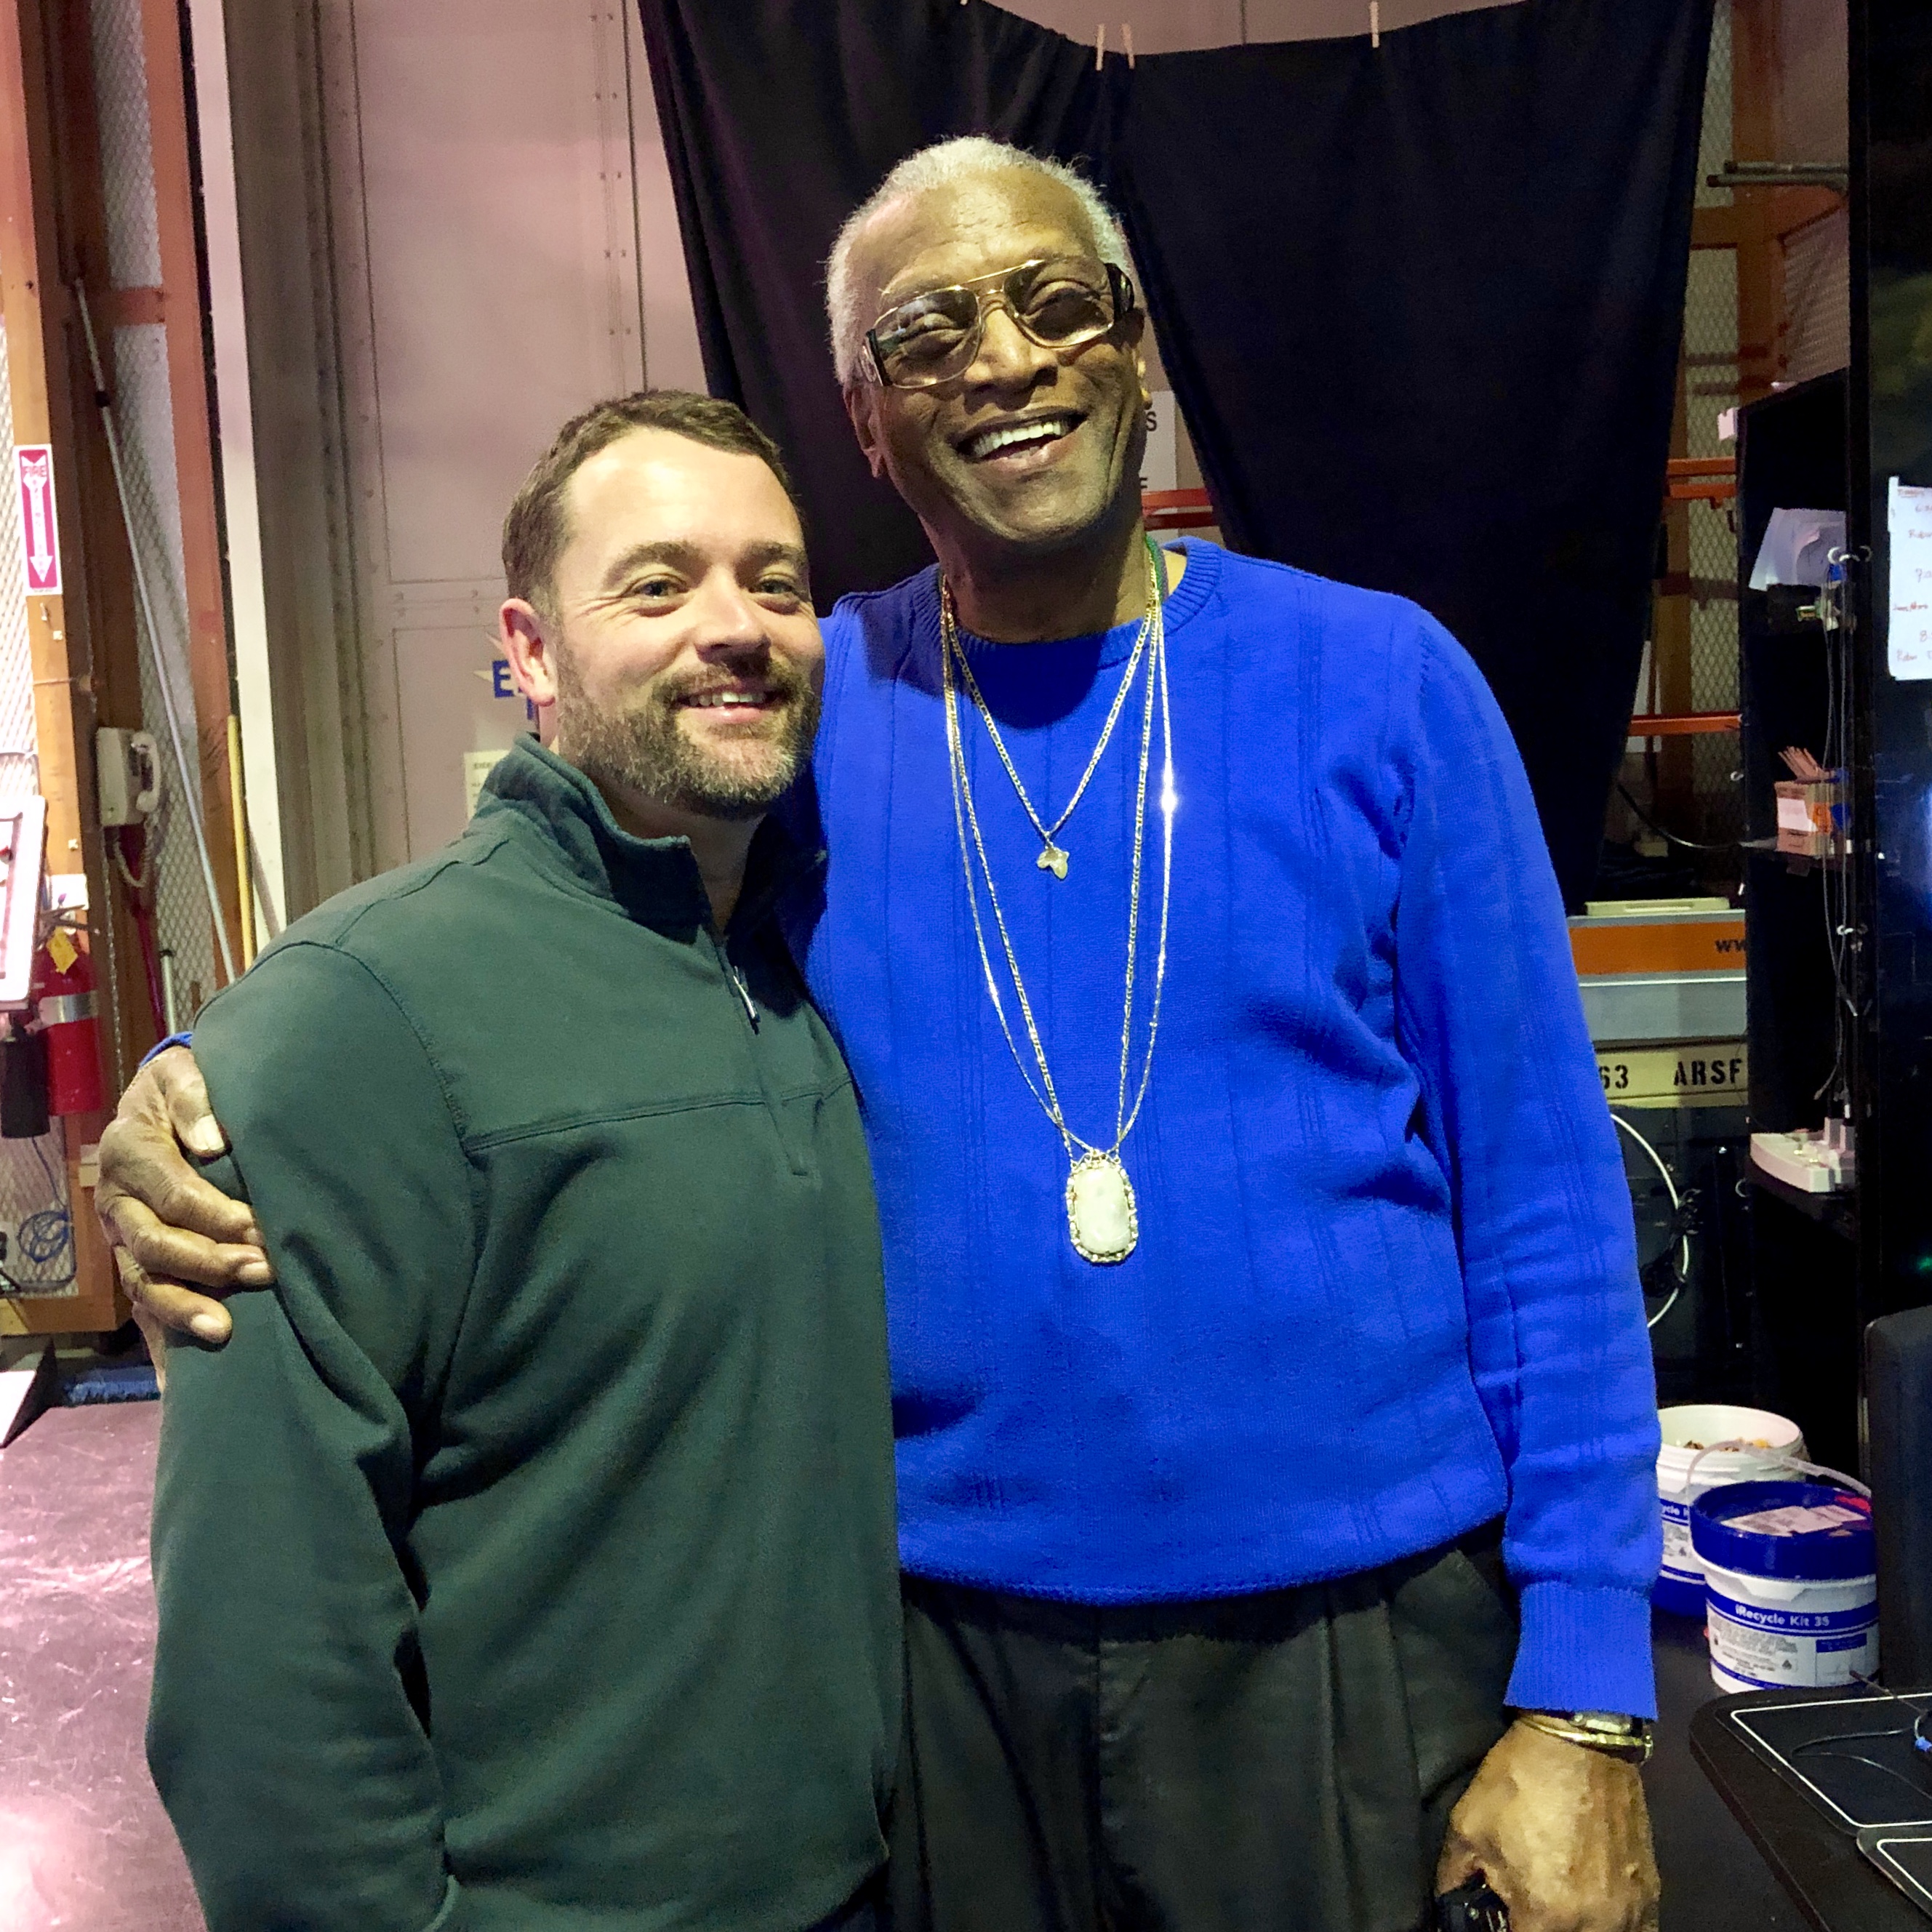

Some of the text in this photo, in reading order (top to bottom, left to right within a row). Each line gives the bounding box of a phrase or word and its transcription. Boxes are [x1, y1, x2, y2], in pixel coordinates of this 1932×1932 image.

[1673, 1059, 1742, 1086] ARSF
[1735, 1603, 1785, 1626] iRecycle
[1789, 1615, 1810, 1627] Kit
